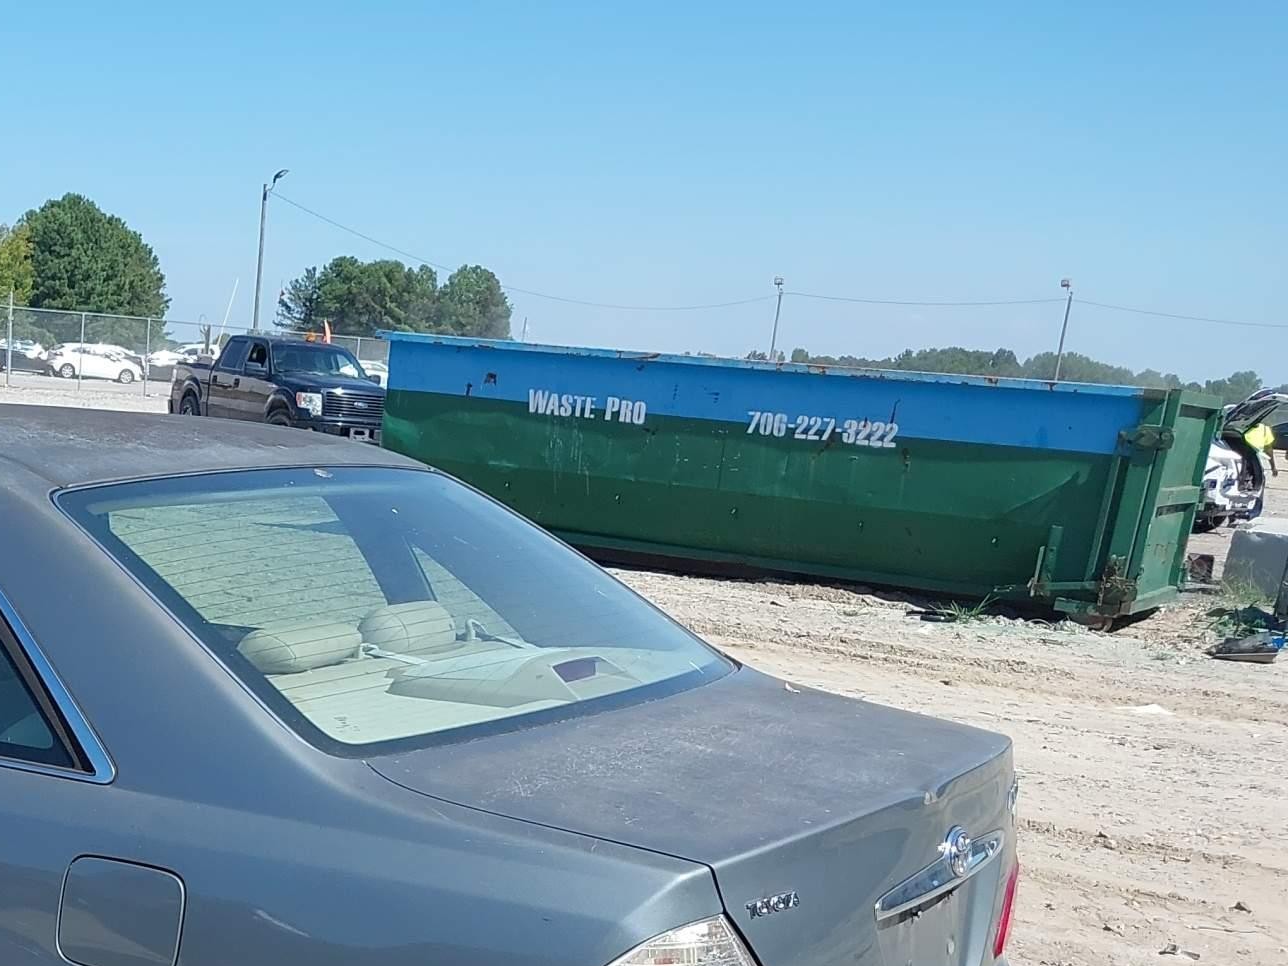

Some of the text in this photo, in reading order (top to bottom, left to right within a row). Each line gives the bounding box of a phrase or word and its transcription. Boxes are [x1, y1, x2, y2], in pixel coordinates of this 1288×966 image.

[528, 388, 647, 425] WASTE PRO
[746, 411, 899, 448] 706-227-3222
